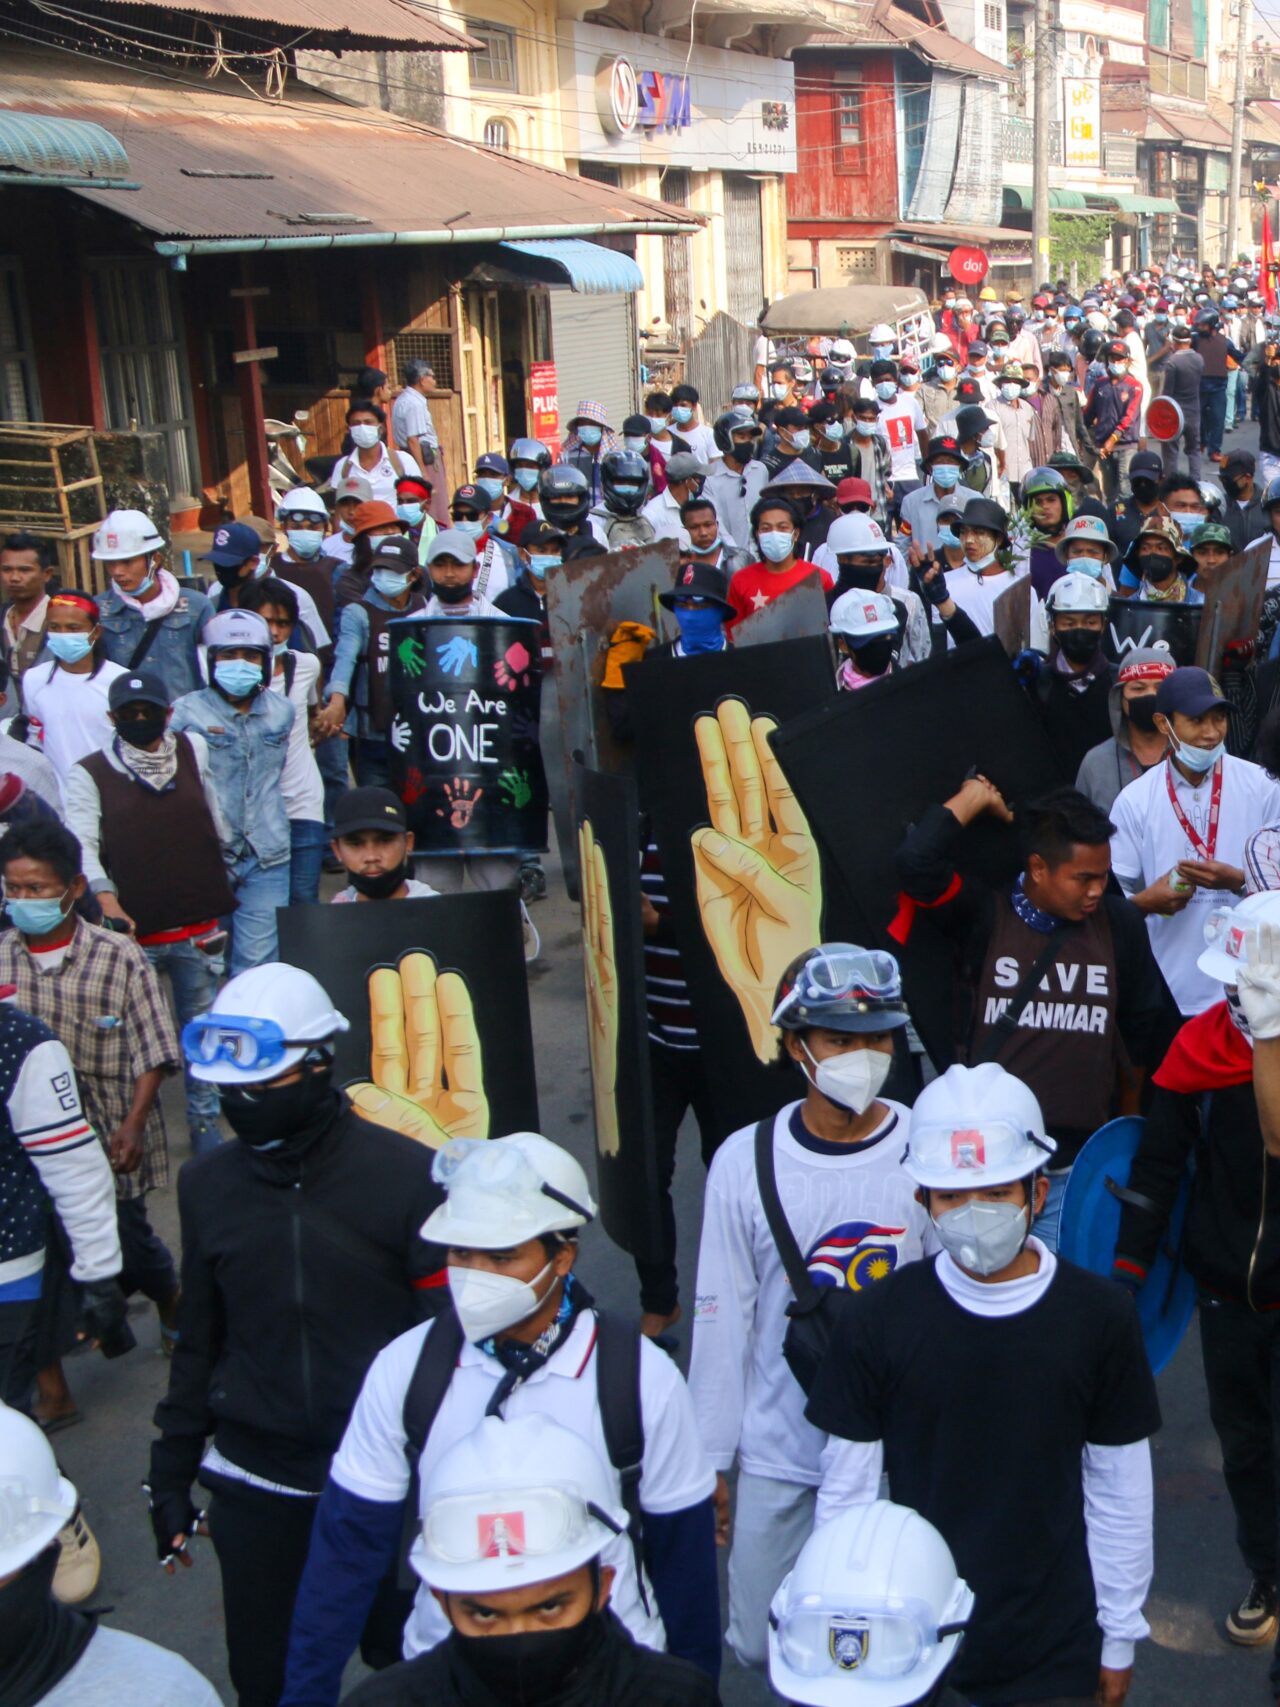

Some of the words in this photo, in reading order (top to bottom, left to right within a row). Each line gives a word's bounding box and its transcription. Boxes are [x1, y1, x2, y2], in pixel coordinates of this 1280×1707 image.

[963, 258, 983, 272] dot
[418, 691, 456, 713] We
[465, 689, 507, 715] Are
[429, 723, 499, 763] ONE
[984, 997, 1108, 1034] MANMAR
